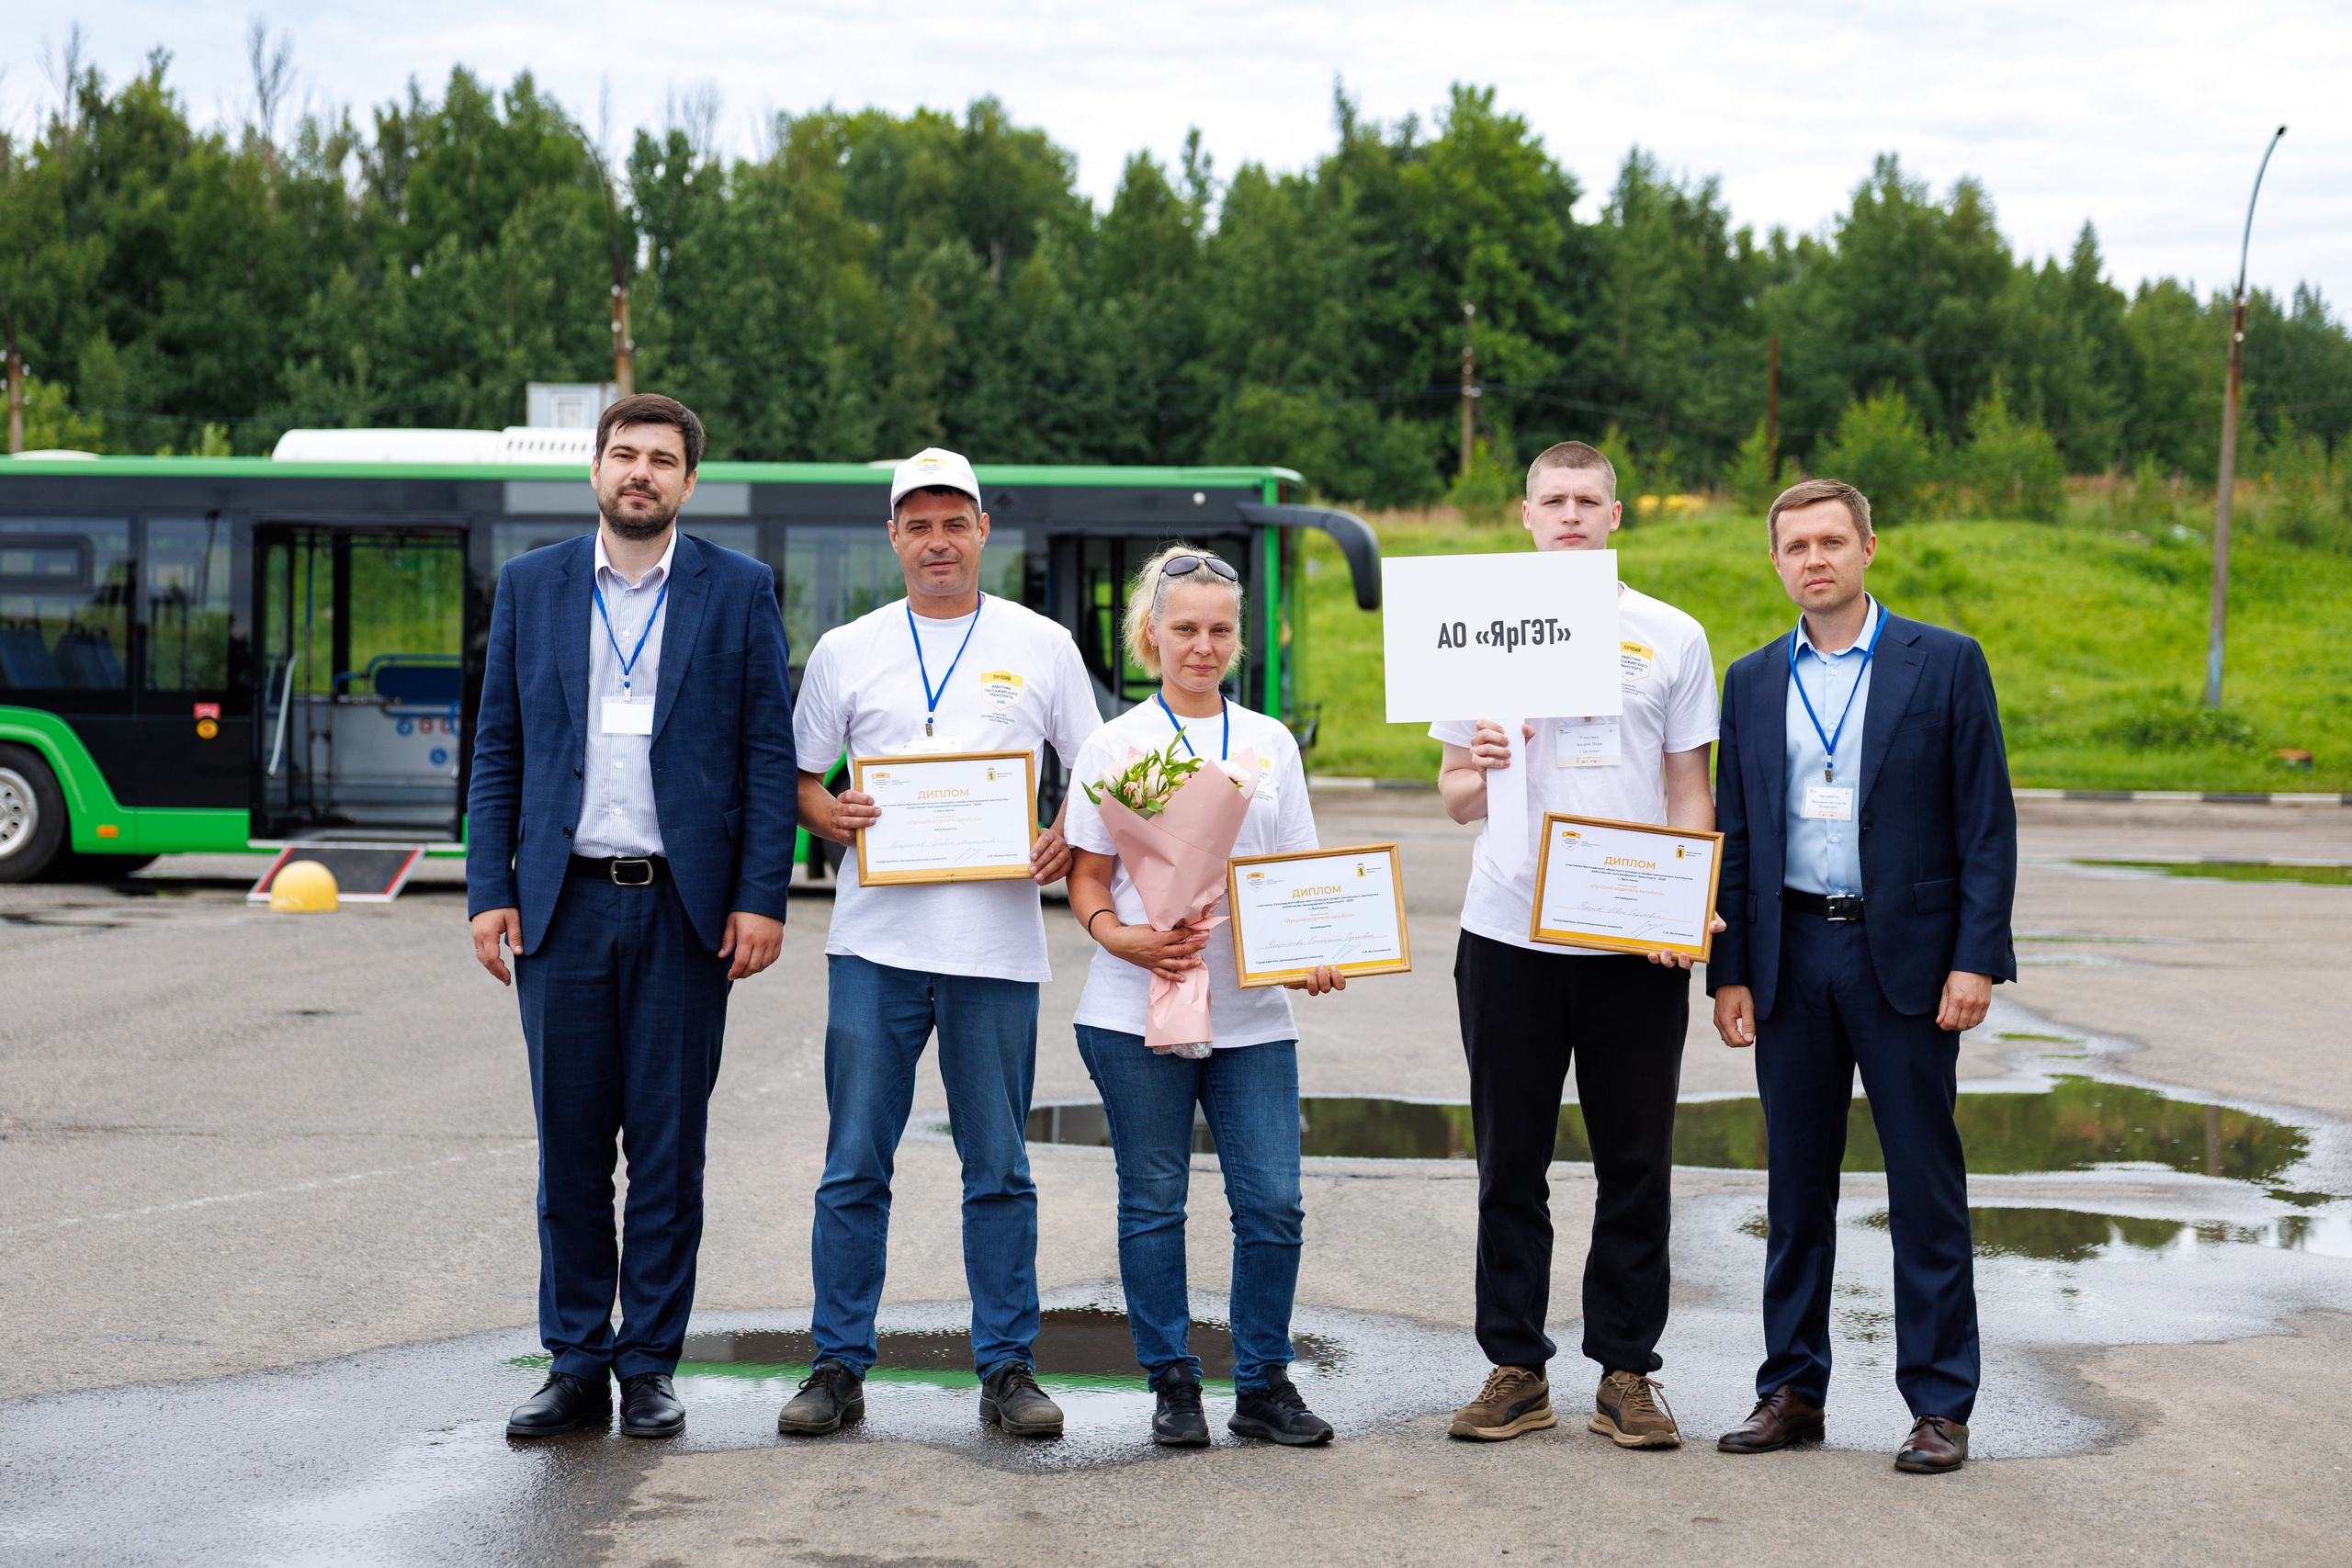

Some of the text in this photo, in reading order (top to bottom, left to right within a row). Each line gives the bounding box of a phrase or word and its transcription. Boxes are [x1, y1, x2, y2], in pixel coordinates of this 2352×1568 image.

[1437, 618, 1571, 653] АО «ЯрГЭТ»
[1623, 644, 1642, 653] ЛУЧШИЙ
[1621, 663, 1643, 672] РАНСПОРТА
[984, 688, 1018, 697] ПАССАЖИРСКОГО
[917, 788, 969, 800] ДИПЛОМ
[1604, 856, 1656, 871] ДИПЛОМ
[1292, 885, 1341, 898] ДИПЛОМ
